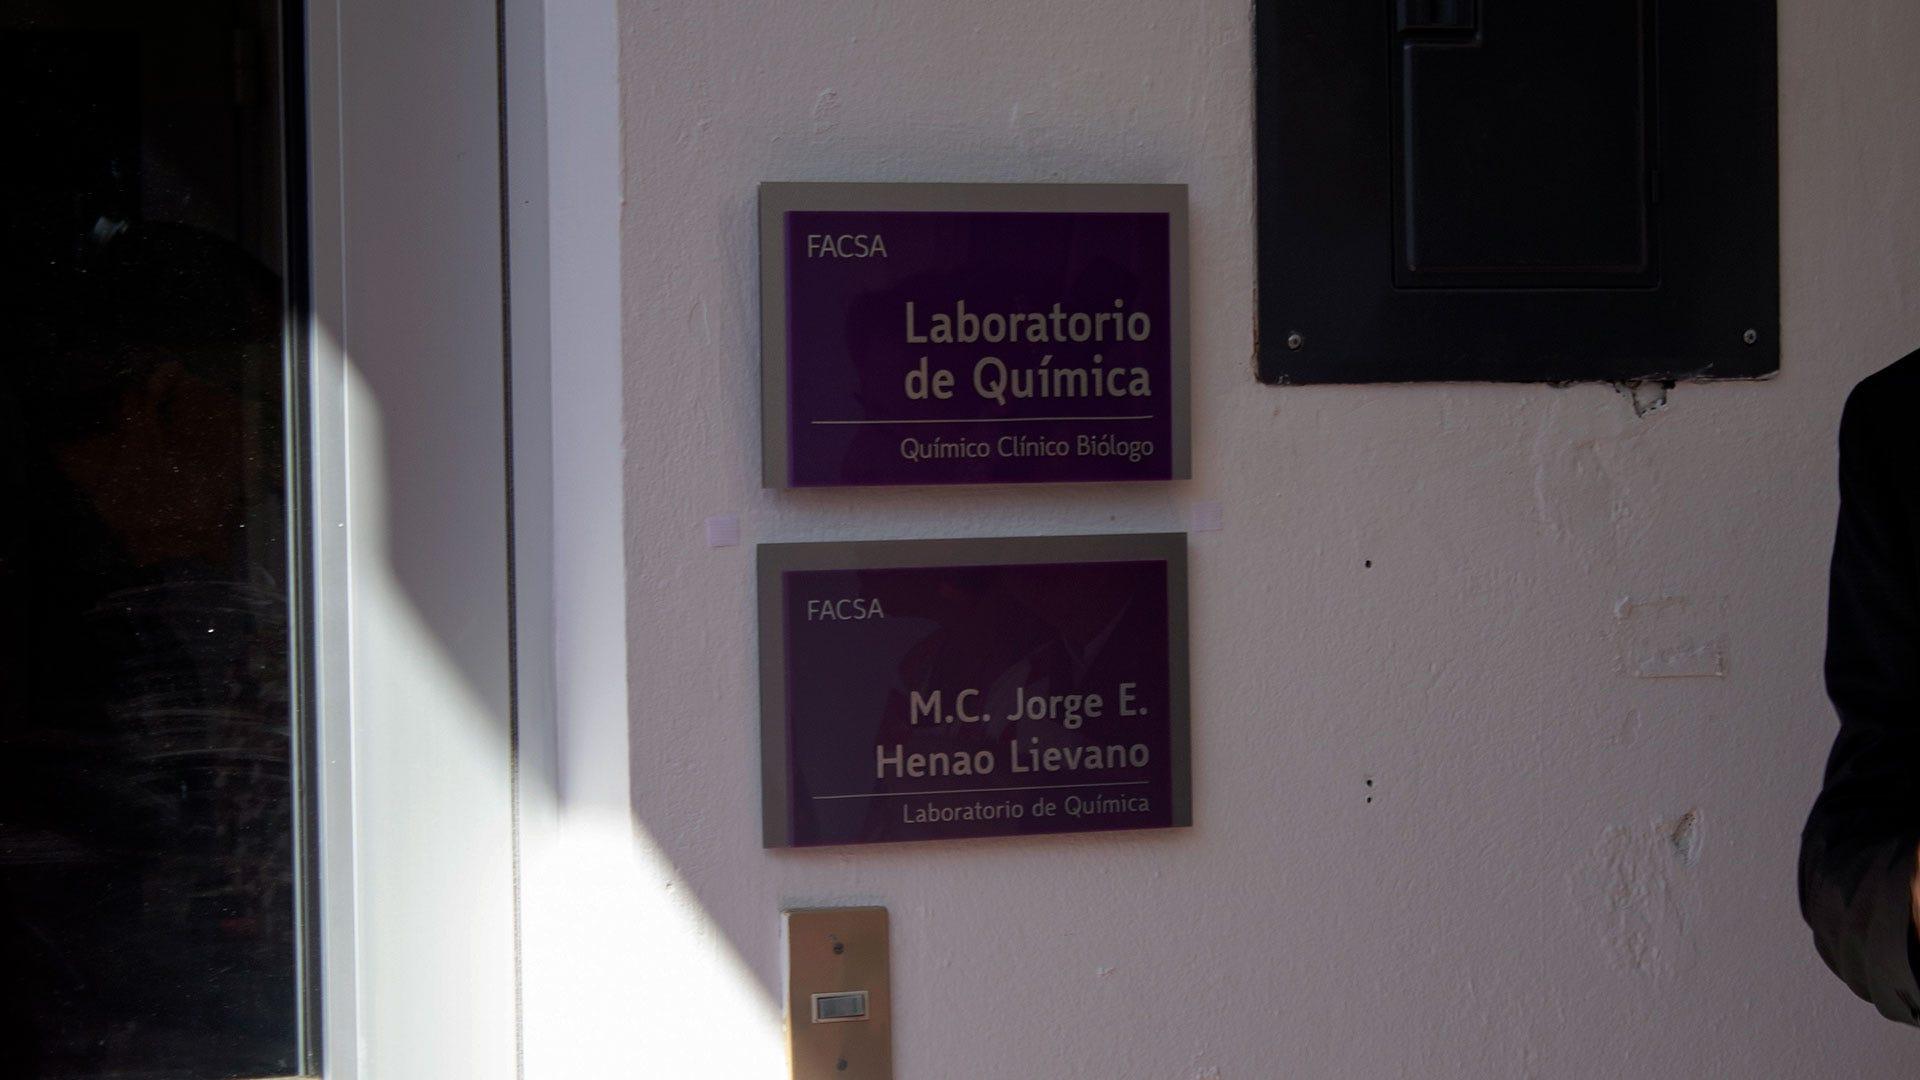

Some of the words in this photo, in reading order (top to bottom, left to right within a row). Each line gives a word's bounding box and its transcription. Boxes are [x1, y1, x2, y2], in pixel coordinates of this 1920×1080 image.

[808, 235, 887, 257] FACSA
[907, 299, 1150, 343] Laboratorio
[905, 357, 954, 399] de
[974, 354, 1151, 405] Química
[901, 437, 990, 462] Químico
[998, 436, 1069, 457] Clínico
[1077, 434, 1153, 462] Biólogo
[808, 599, 883, 620] FACSA
[911, 689, 990, 724] M.C.
[1007, 687, 1102, 729] Jorge
[1120, 683, 1147, 716] E.
[877, 745, 994, 778] Henao
[1011, 737, 1148, 772] Lievano
[904, 801, 1023, 823] Laboratorio
[1032, 798, 1056, 816] de
[1065, 794, 1149, 817] Química
